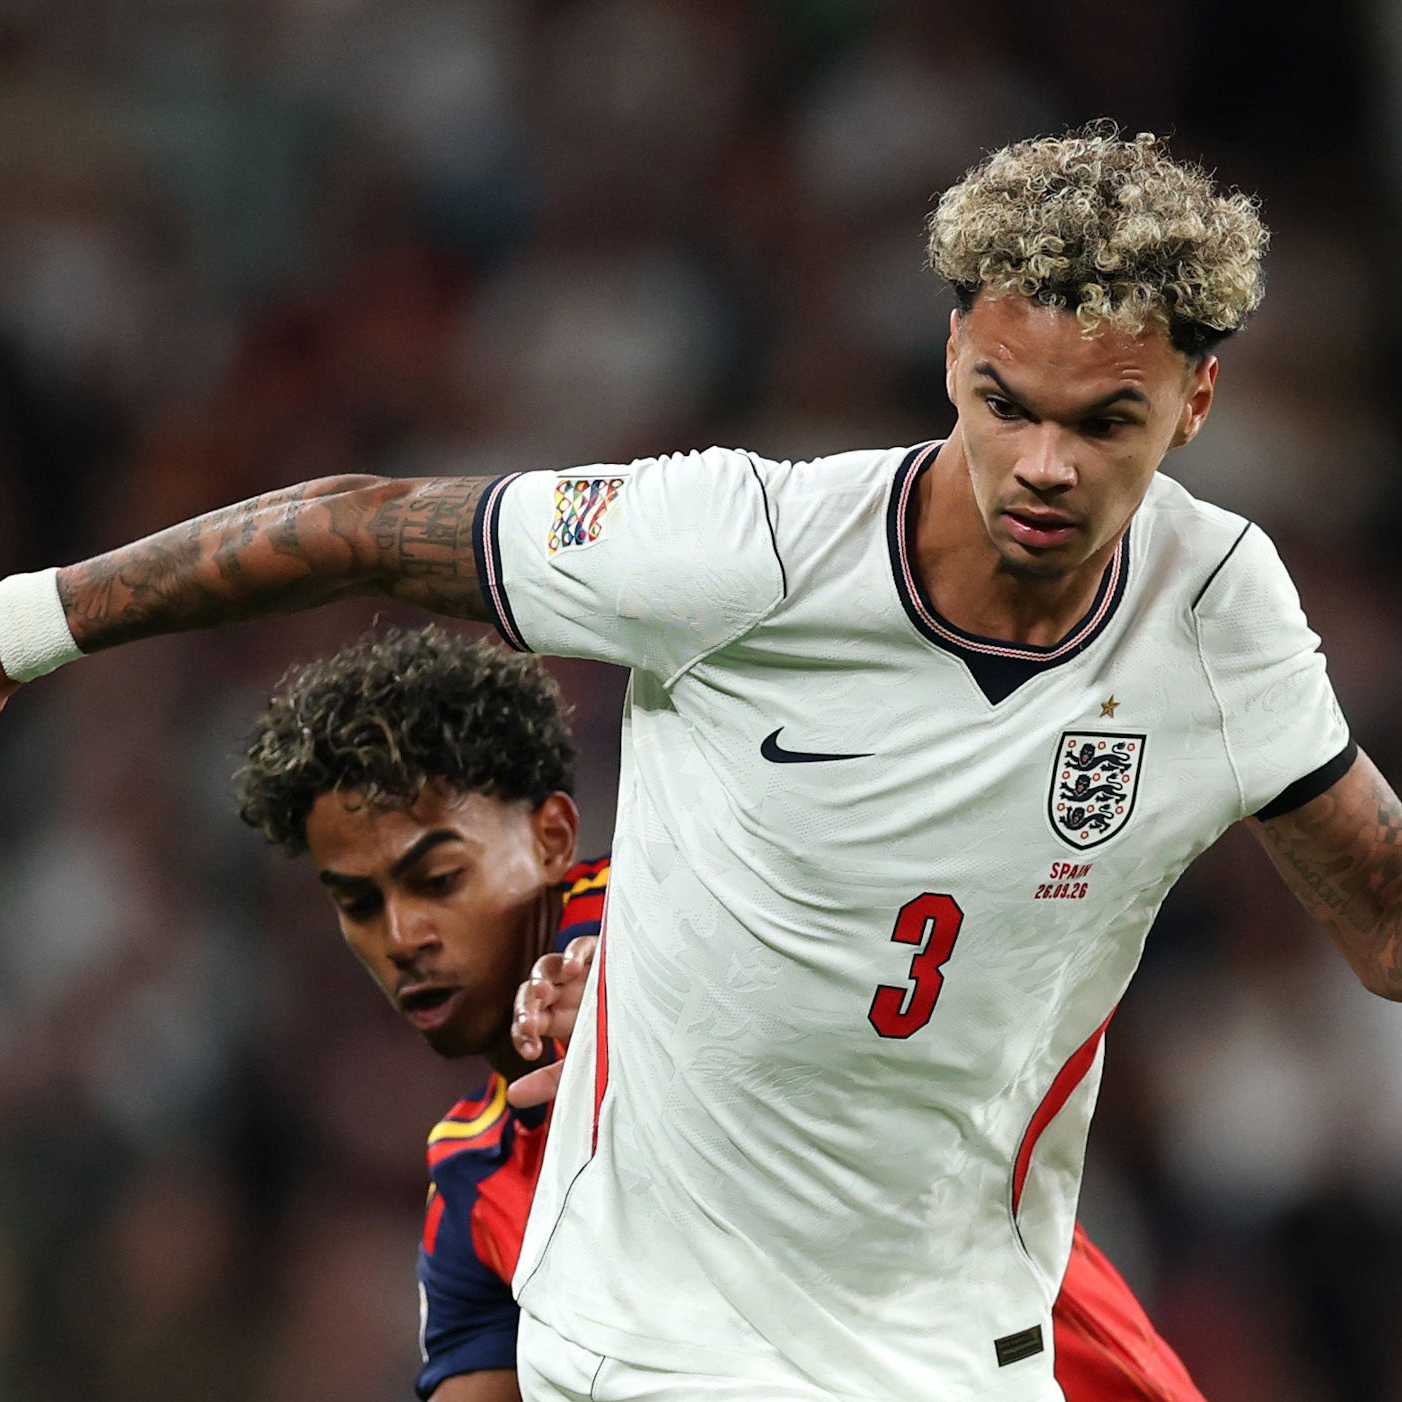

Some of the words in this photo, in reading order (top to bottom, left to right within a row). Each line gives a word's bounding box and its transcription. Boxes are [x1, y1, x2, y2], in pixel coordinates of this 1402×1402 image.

[1049, 861, 1093, 880] SPAIN
[1033, 882, 1089, 900] 26.09.26
[867, 891, 965, 1040] 3
